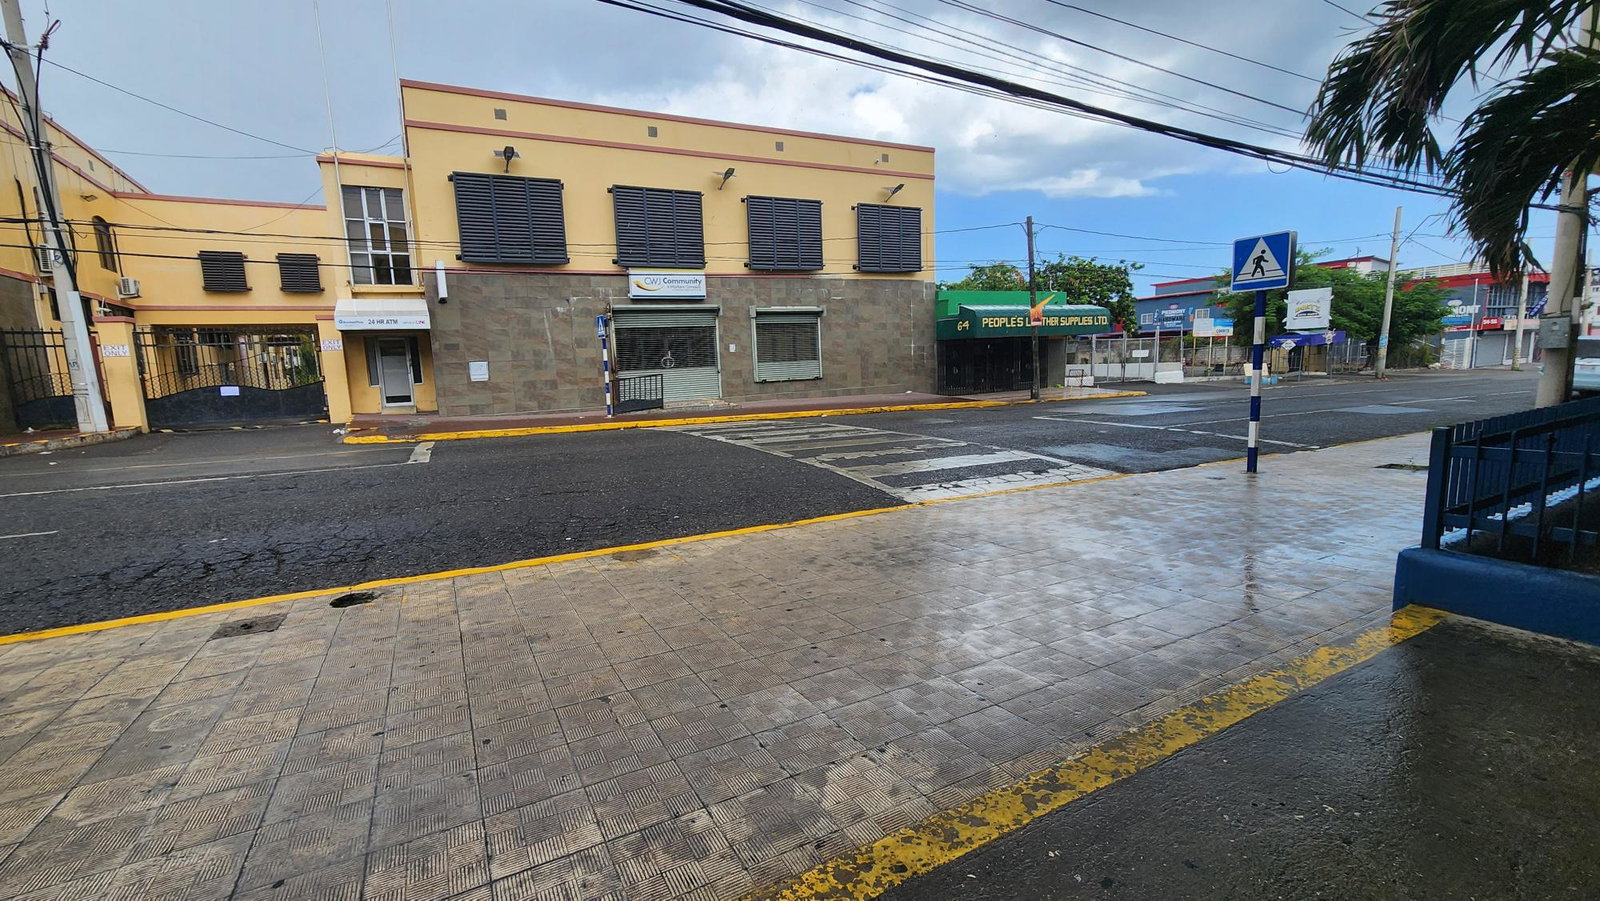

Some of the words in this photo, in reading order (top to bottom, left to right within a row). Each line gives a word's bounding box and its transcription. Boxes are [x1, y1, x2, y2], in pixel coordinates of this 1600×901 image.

[644, 277, 661, 285] CWJ
[662, 277, 702, 285] Community
[957, 320, 970, 331] 64
[982, 315, 1024, 328] PEOPLE'S
[1025, 316, 1059, 327] LTHER
[1060, 316, 1093, 326] SUPPLIES
